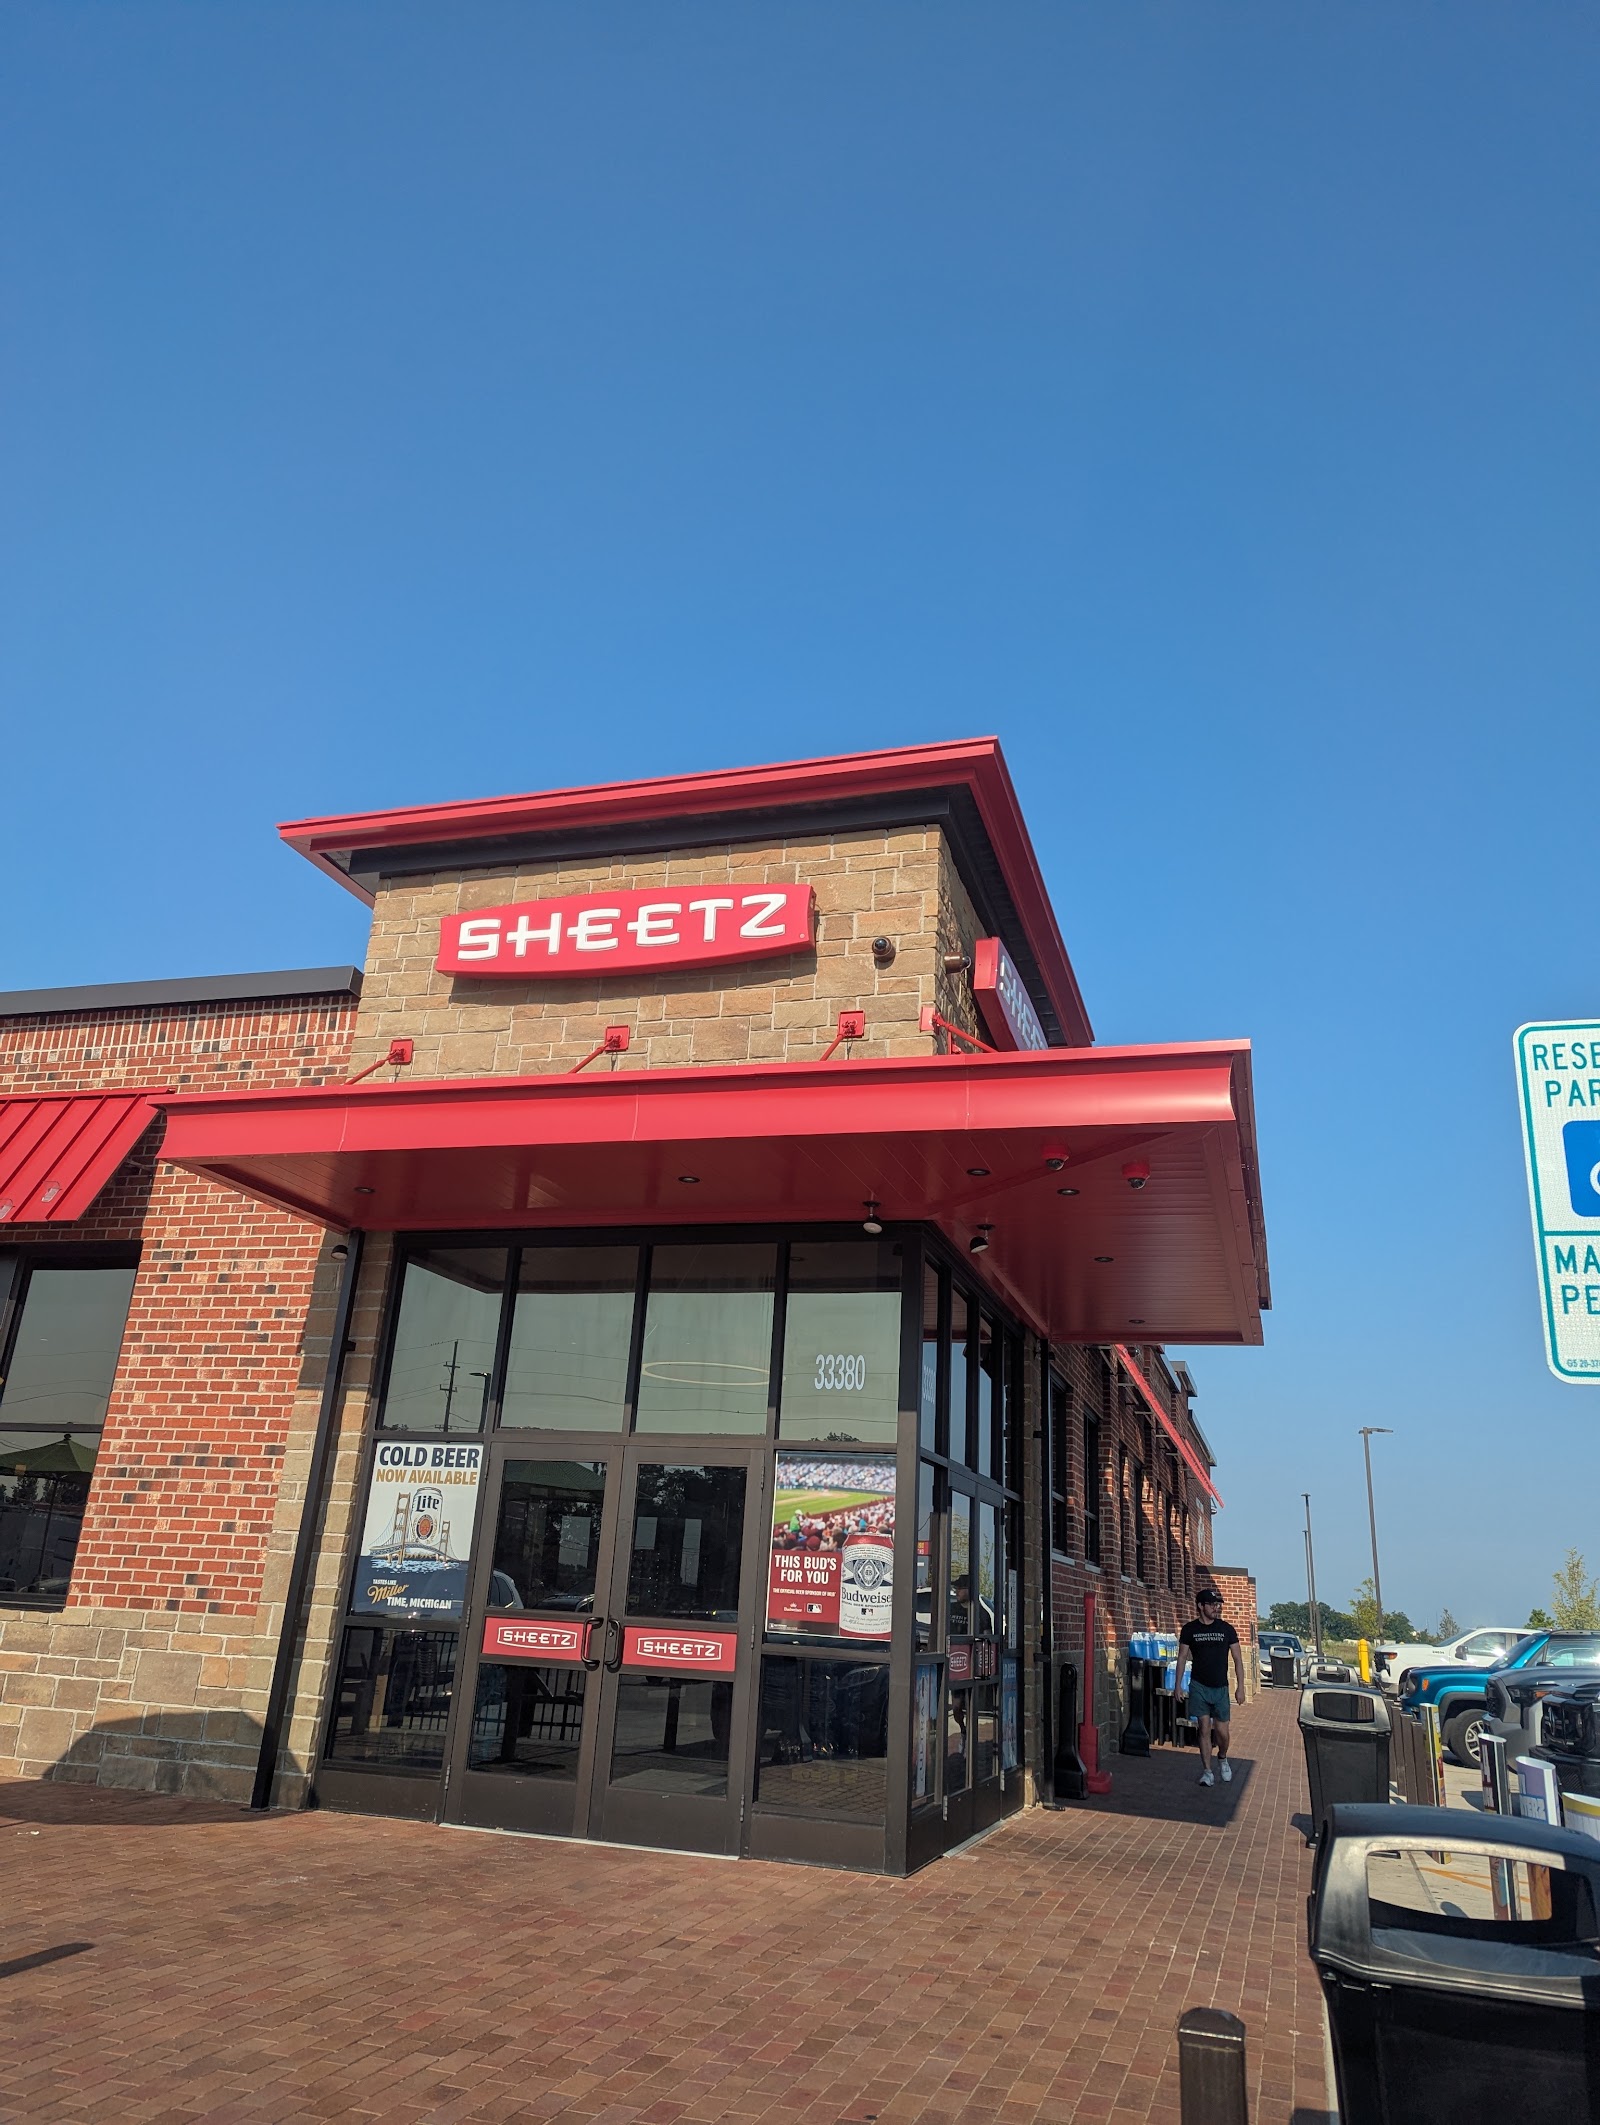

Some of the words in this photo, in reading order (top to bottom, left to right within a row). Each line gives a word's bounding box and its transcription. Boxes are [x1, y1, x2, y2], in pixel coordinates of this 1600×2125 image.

[457, 893, 788, 961] SHEETZ
[1554, 1244, 1600, 1274] MA
[1561, 1285, 1600, 1316] PE
[814, 1354, 866, 1390] 33380
[379, 1446, 428, 1467] COLD
[430, 1447, 480, 1468] BEER
[375, 1468, 408, 1483] NOW
[408, 1470, 478, 1485] AVAILABLE
[416, 1495, 440, 1512] Lite
[774, 1554, 801, 1569] THIS
[803, 1556, 837, 1571] BUD'S
[780, 1569, 803, 1583] FOR
[806, 1570, 829, 1585] YOU
[367, 1583, 410, 1605] Miller
[387, 1597, 409, 1608] TIME,
[410, 1598, 452, 1609] MICHIGAN
[503, 1630, 571, 1646] SHEETZ
[643, 1641, 716, 1657] SHEETZ
[950, 1656, 967, 1668] SHEETZ
